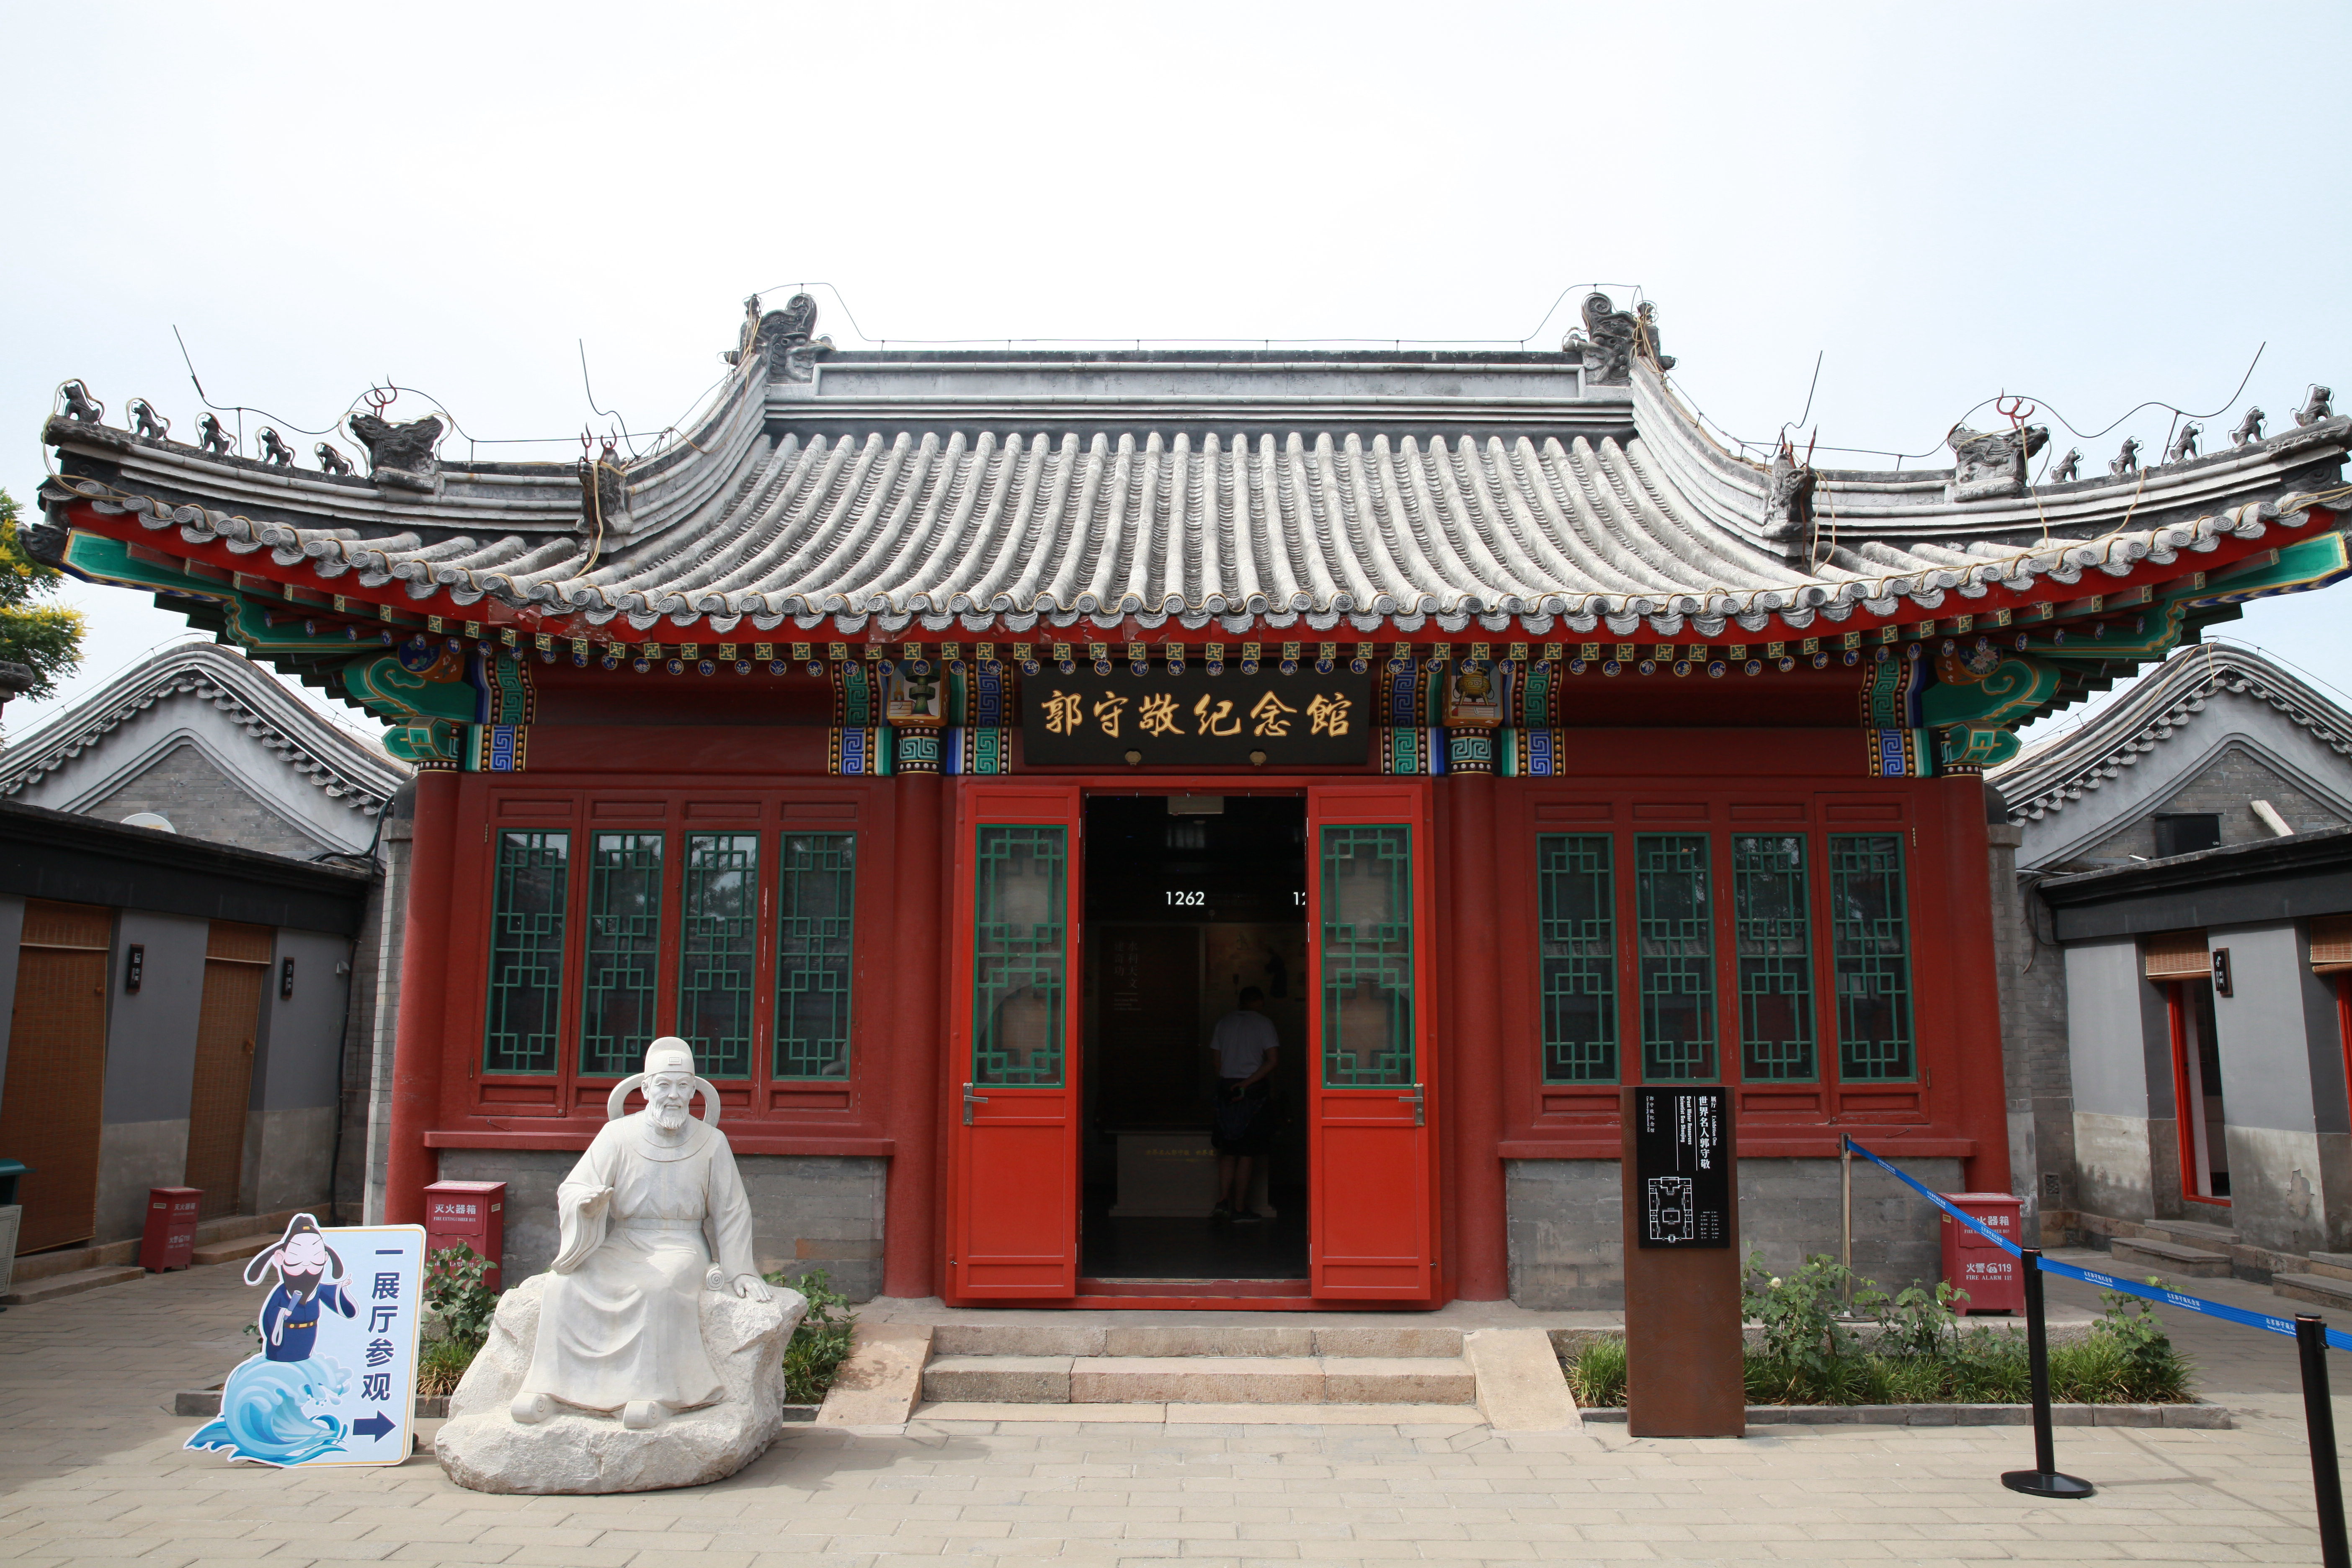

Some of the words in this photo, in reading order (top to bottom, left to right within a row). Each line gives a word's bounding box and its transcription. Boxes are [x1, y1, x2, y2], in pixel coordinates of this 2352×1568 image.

[1166, 892, 1204, 905] 1262
[1698, 1096, 1710, 1169] 世界名人郭守敬
[434, 1204, 476, 1214] 灭火器箱
[1965, 1216, 2009, 1226] 火器箱
[1966, 1263, 1985, 1273] 火警
[1998, 1263, 2012, 1272] 119
[361, 1249, 404, 1402] 一展厅参观
